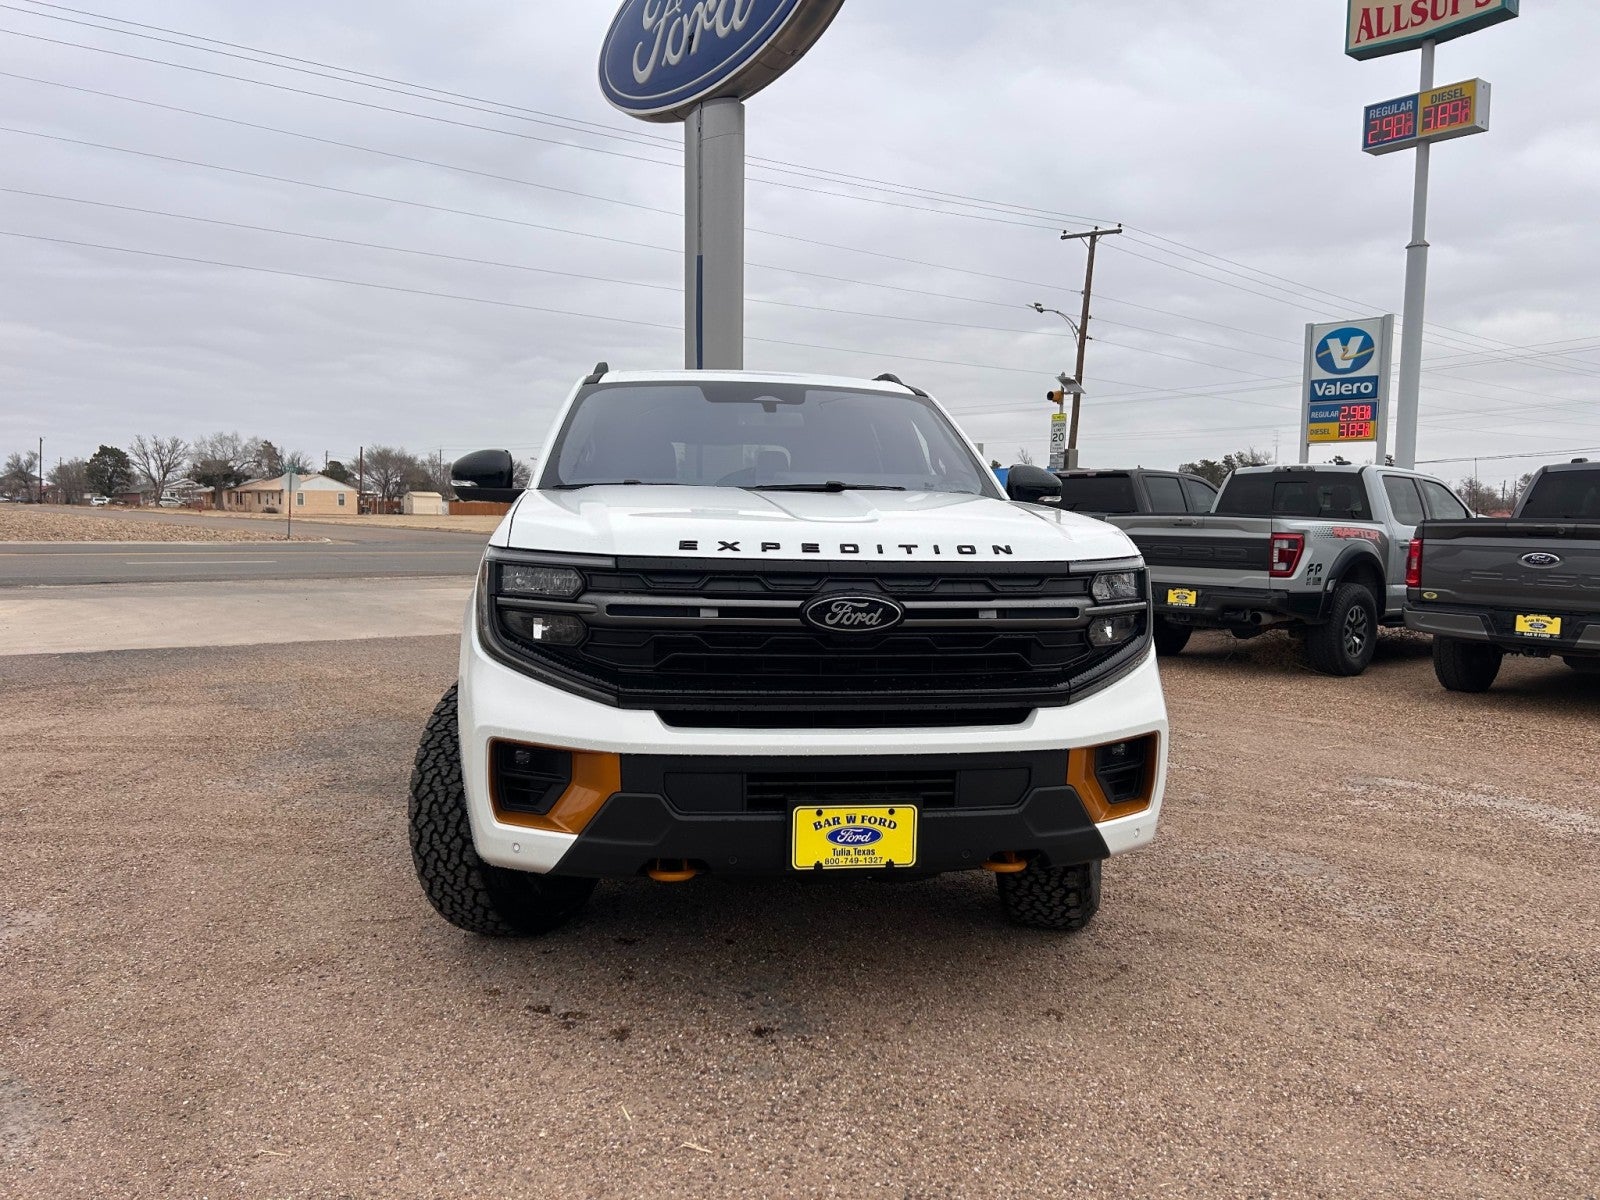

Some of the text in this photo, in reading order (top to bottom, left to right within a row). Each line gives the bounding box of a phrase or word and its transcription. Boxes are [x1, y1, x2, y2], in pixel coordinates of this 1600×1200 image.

[1355, 0, 1492, 43] ALLSU
[632, 0, 755, 84] Ford
[1430, 88, 1465, 104] DIESEL
[1369, 100, 1413, 119] REGULAR
[1314, 381, 1373, 396] Valero
[1311, 410, 1339, 418] REGULAR
[1052, 433, 1064, 442] 20
[1332, 526, 1380, 543] RAPTOR
[678, 540, 1014, 555] EXPEDITION
[825, 600, 883, 626] Ford
[813, 813, 897, 831] BAR W FORD
[836, 828, 872, 843] Ford
[832, 848, 876, 857] Tulia, Texas
[824, 856, 883, 865] 800-749-1327
